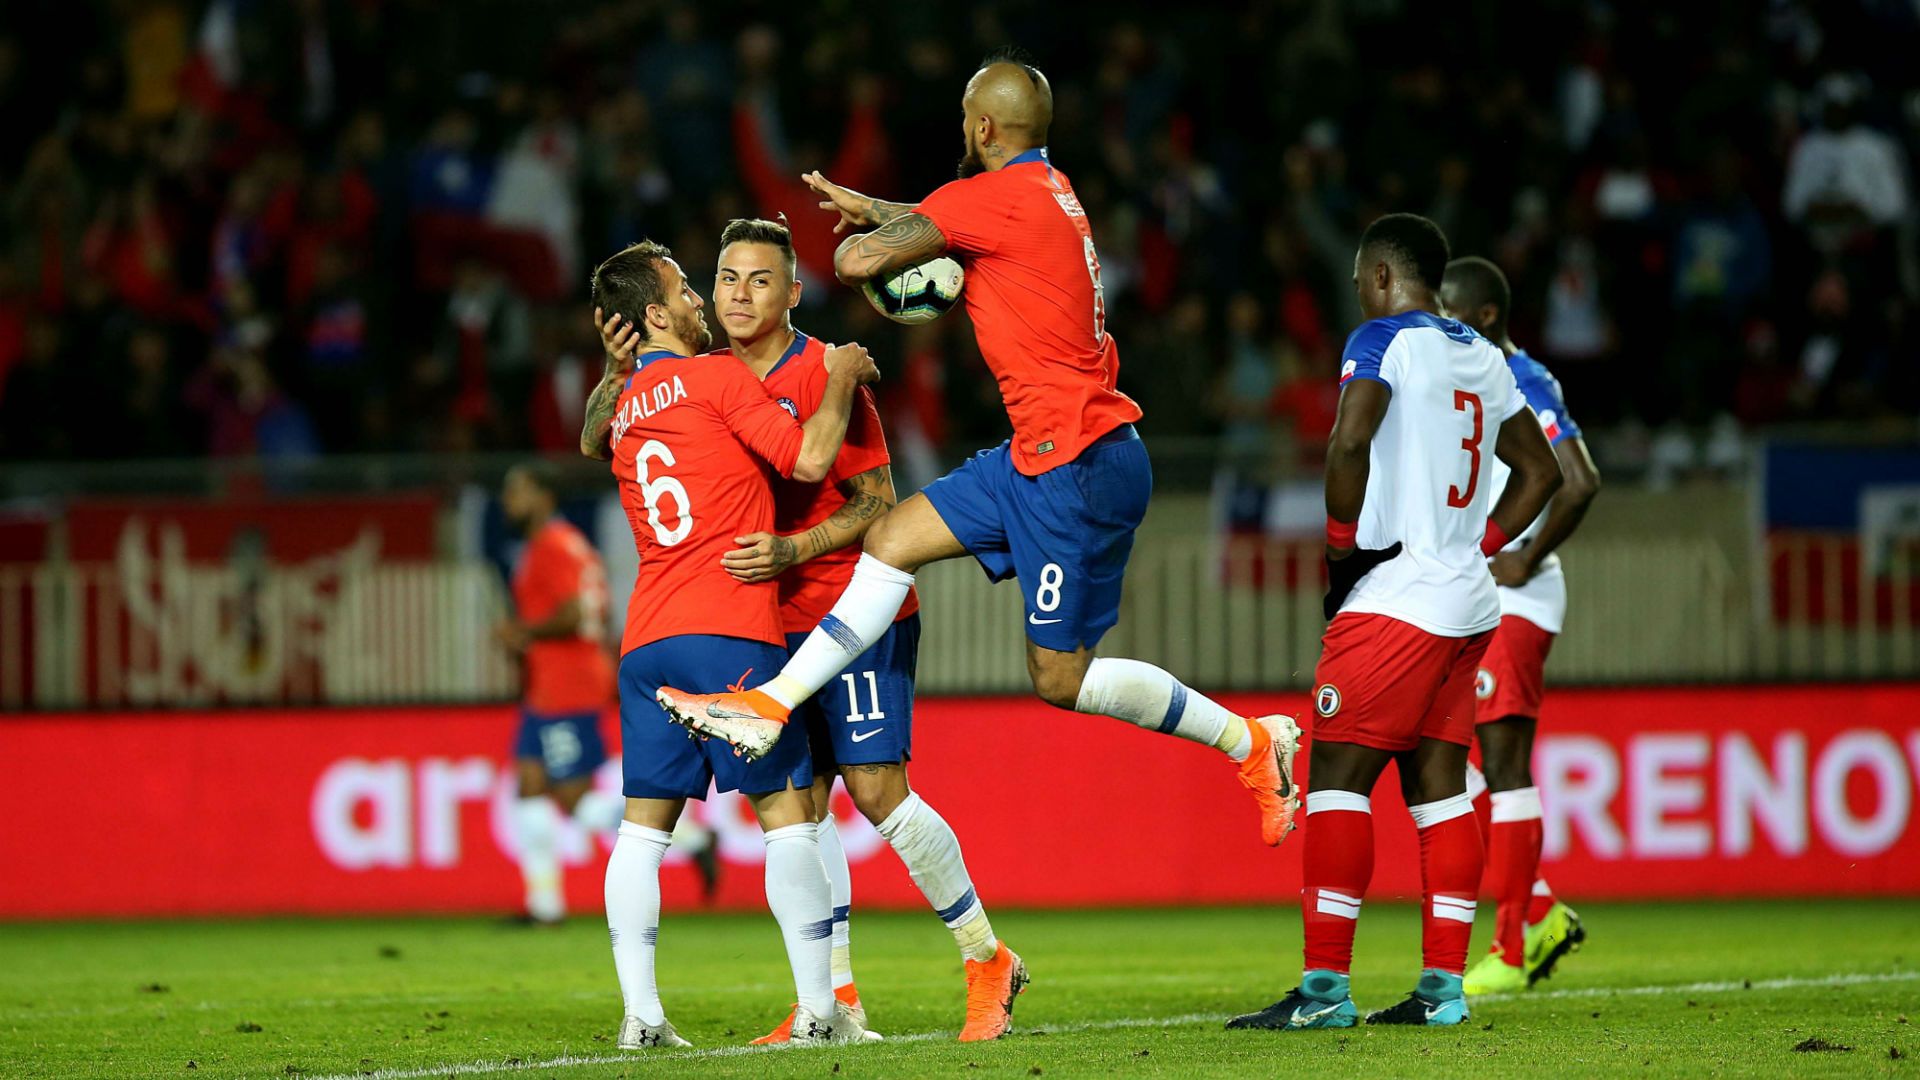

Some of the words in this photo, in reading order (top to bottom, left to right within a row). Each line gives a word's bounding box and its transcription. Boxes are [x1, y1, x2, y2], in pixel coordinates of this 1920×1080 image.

[636, 439, 693, 547] 6
[1446, 390, 1483, 509] 3
[1036, 562, 1064, 613] 8
[840, 670, 885, 723] 11
[1537, 727, 1920, 860] RENO
